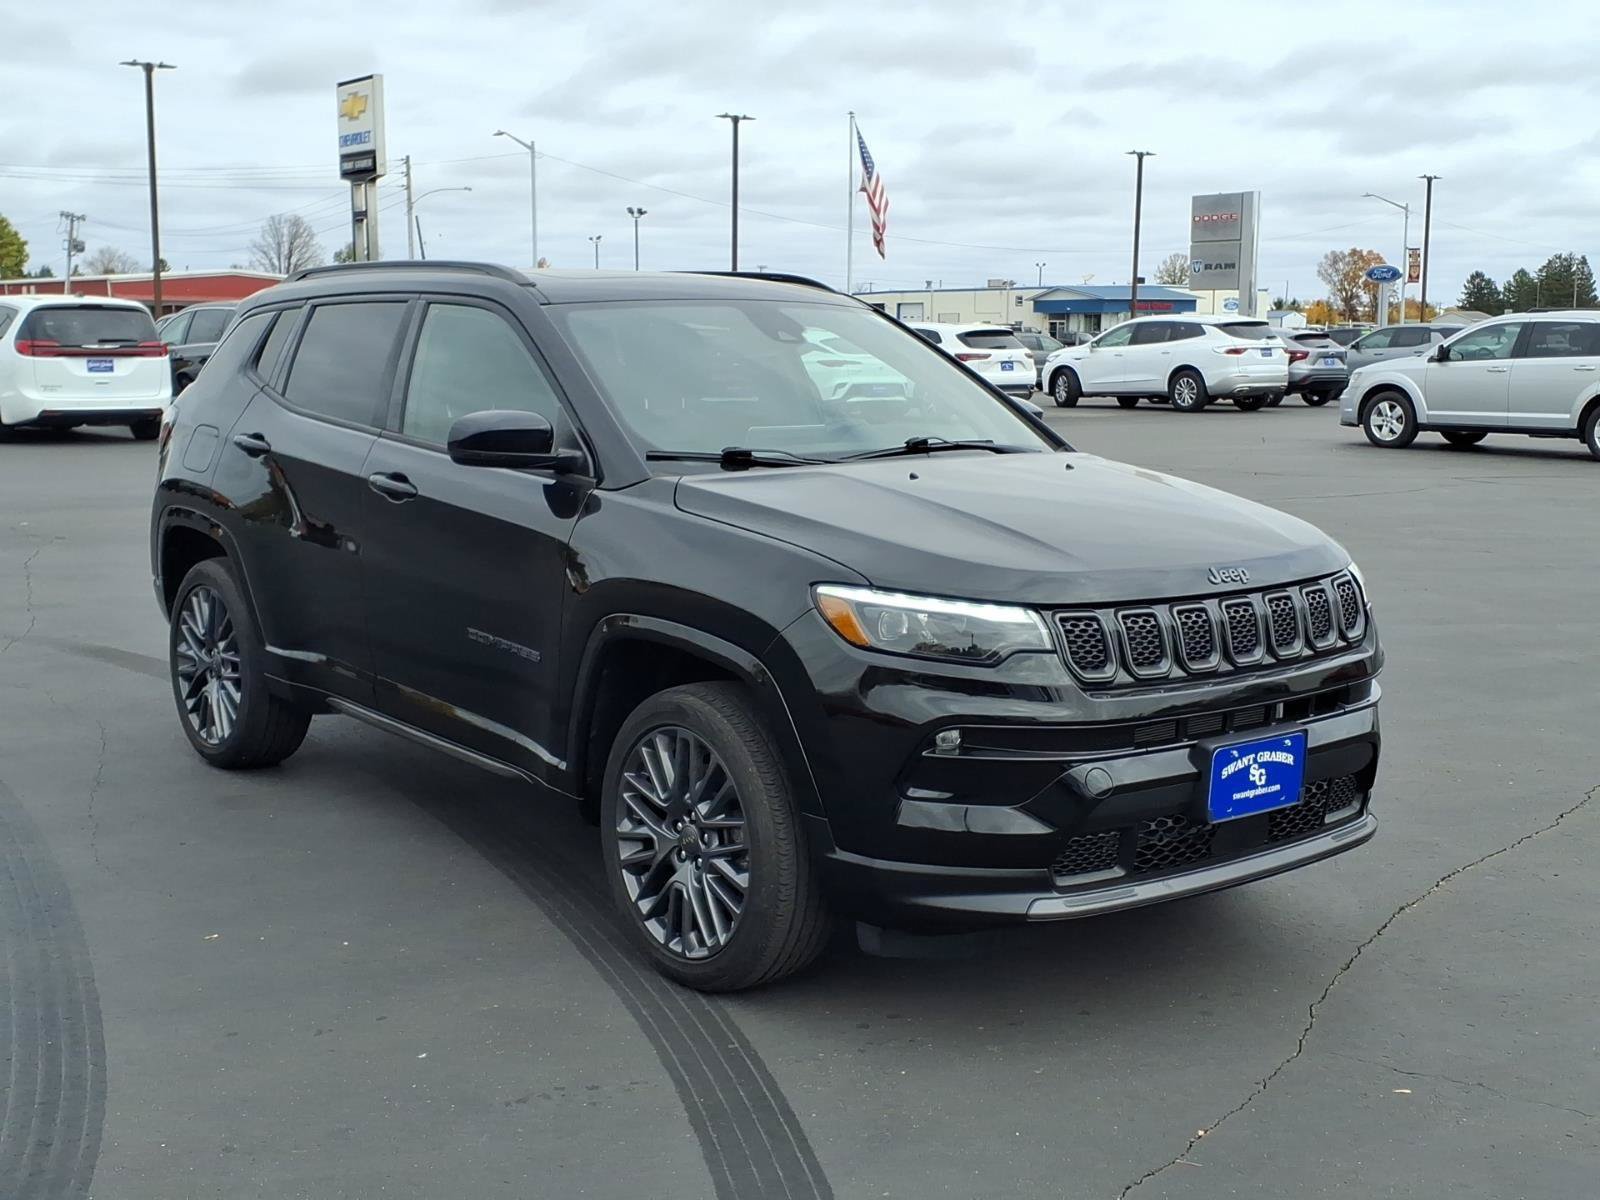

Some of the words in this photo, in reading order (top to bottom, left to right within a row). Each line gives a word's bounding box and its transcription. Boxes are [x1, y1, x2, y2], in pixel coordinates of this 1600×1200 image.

[339, 131, 371, 147] CHEVROLET
[1192, 212, 1239, 223] DODGE
[1204, 262, 1236, 271] RAM
[1371, 268, 1394, 279] Ford
[1208, 566, 1250, 585] Jeep
[1221, 753, 1256, 780] SWANT
[1256, 750, 1295, 765] GRABER
[1249, 763, 1267, 786] SG
[1232, 784, 1281, 801] swantgraber.com
